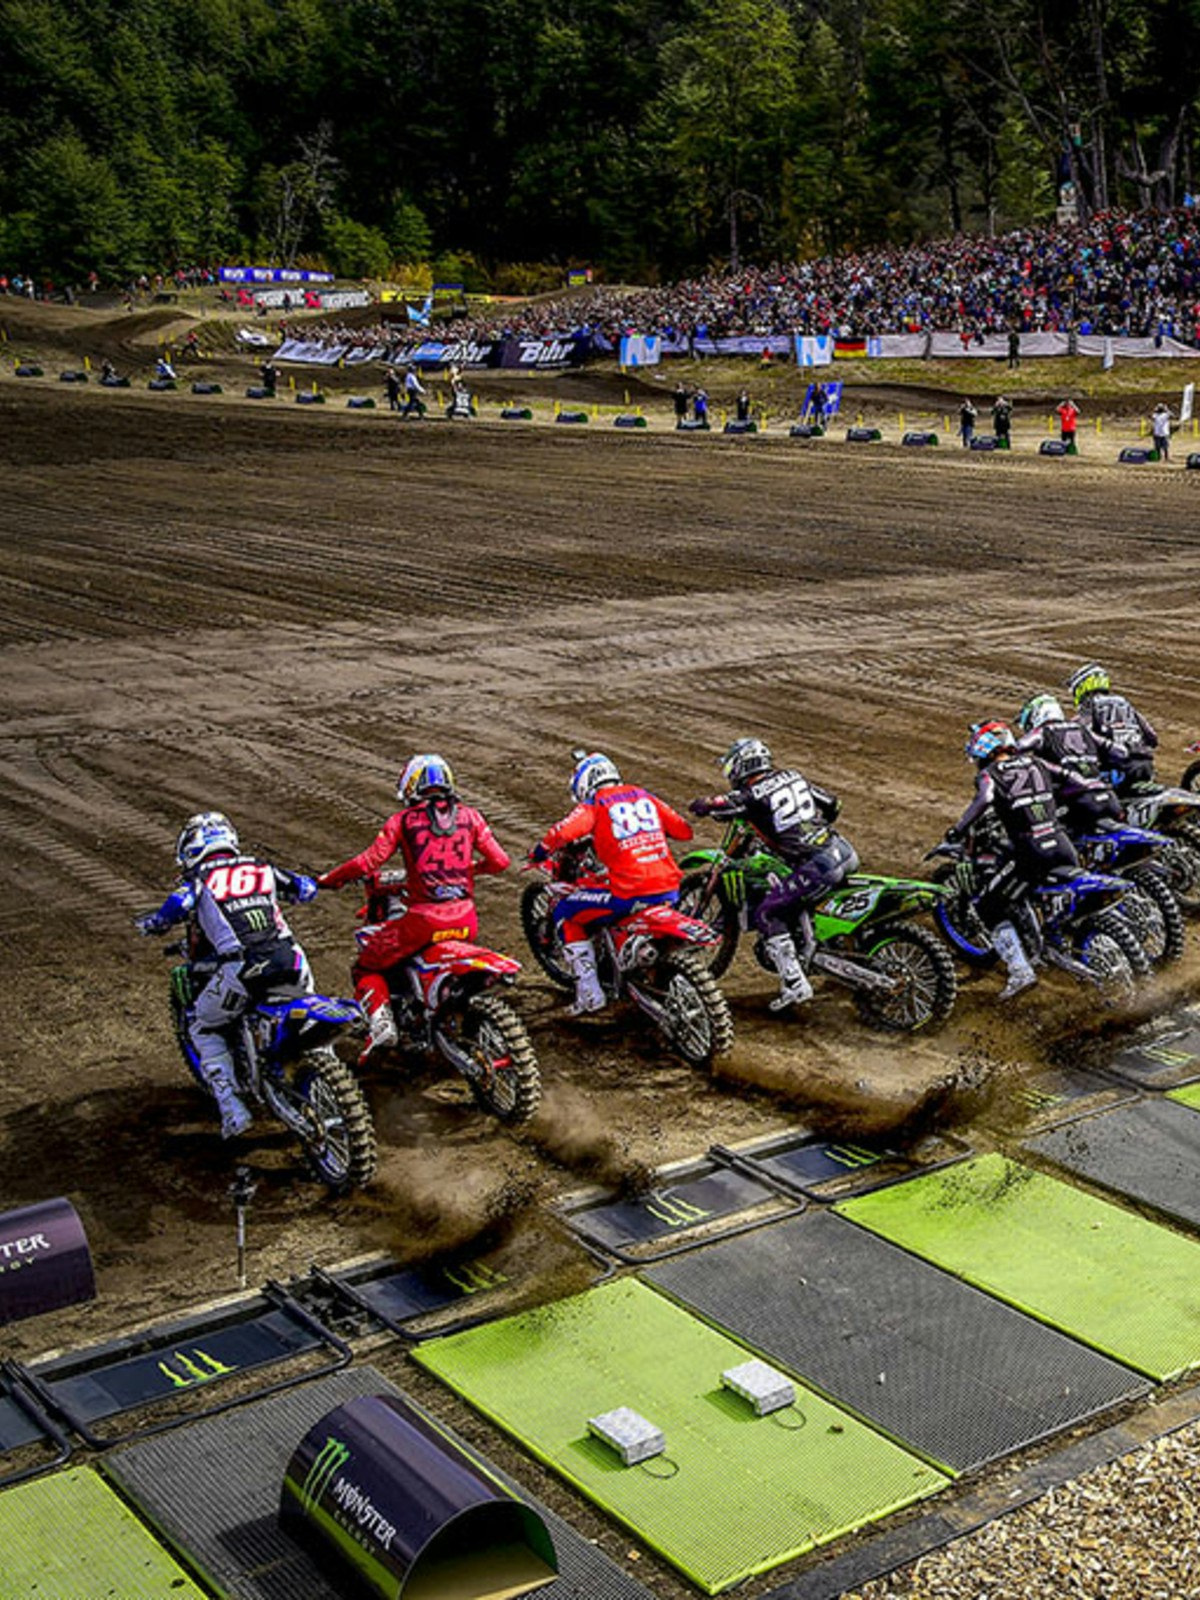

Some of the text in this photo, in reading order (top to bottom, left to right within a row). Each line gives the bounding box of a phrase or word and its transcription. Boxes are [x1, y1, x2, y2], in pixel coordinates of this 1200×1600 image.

[1002, 765, 1047, 798] 21
[609, 797, 662, 841] 89
[770, 779, 817, 834] 25
[416, 830, 472, 874] 243
[206, 865, 271, 900] 461
[0, 1233, 51, 1258] TER
[332, 1477, 397, 1550] MONSTER
